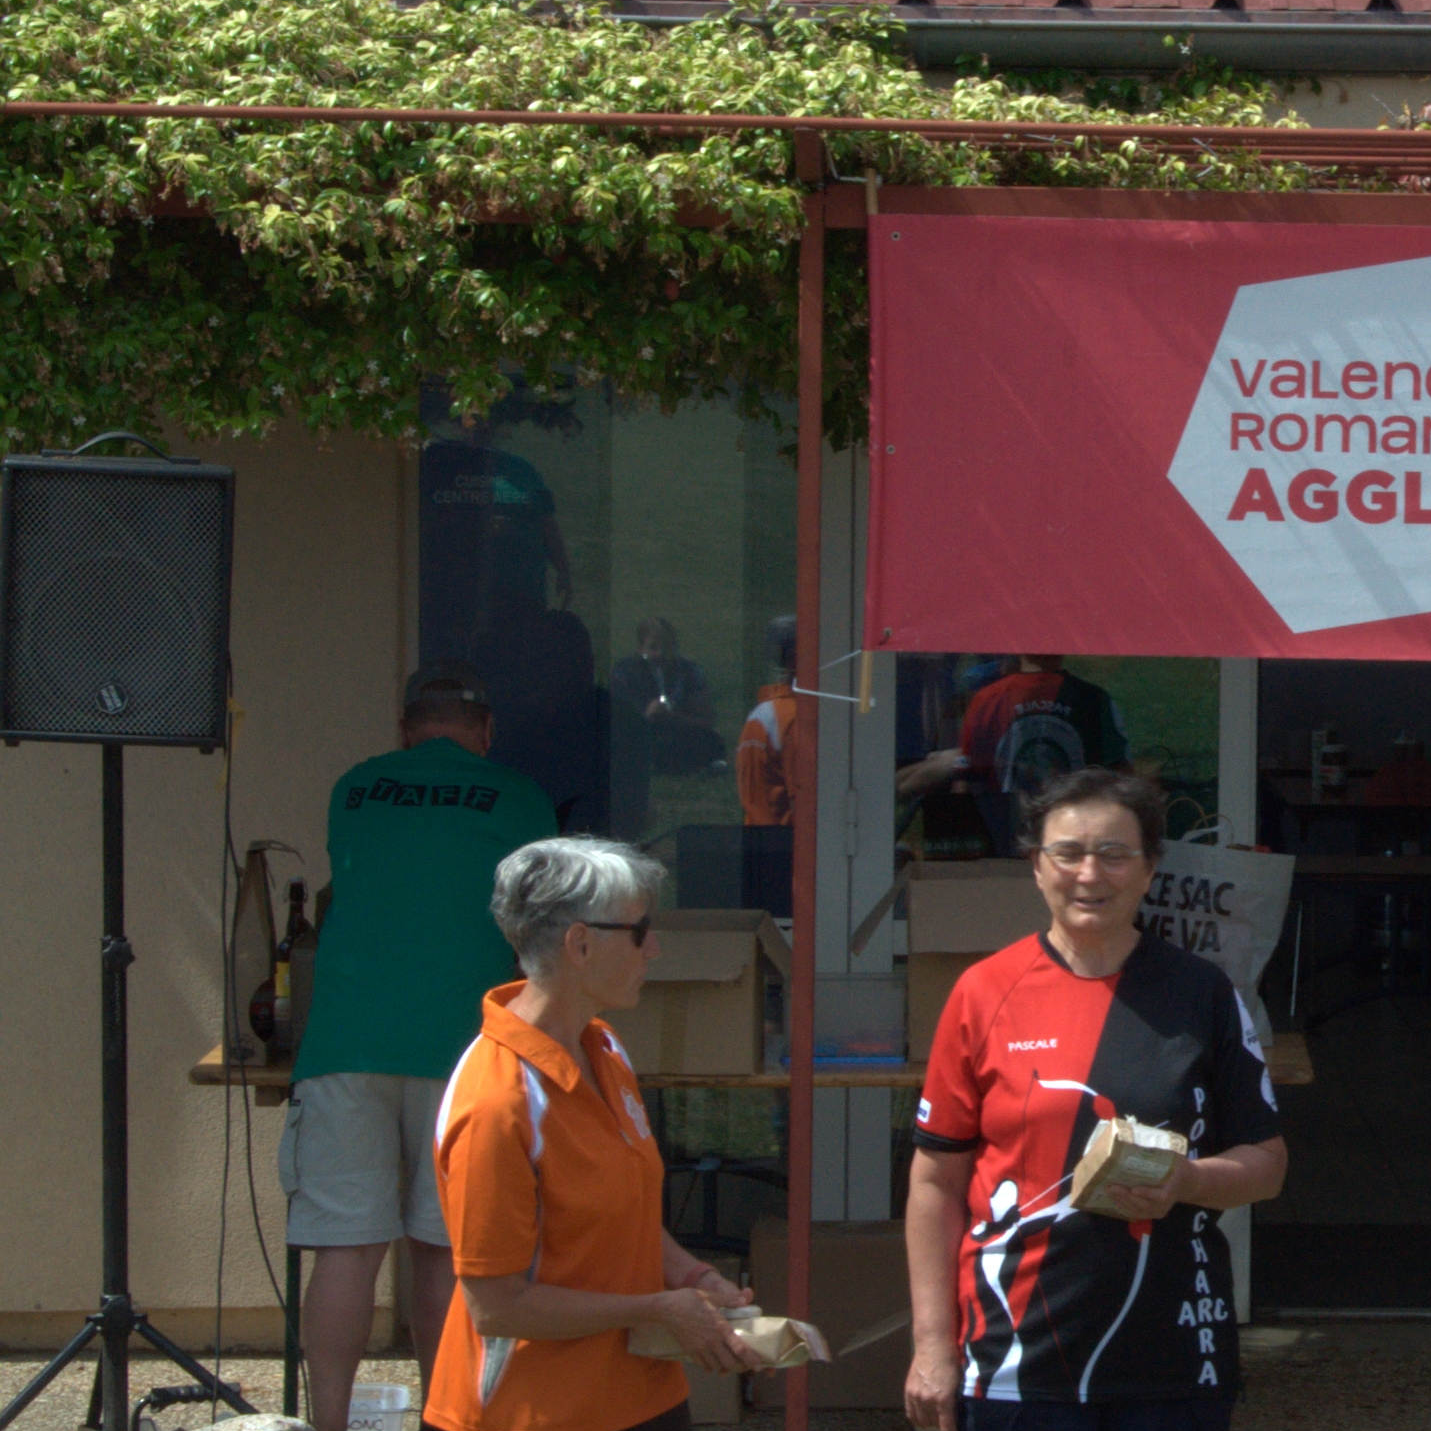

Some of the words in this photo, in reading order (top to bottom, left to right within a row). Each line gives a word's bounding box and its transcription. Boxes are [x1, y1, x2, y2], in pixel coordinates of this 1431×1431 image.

[346, 778, 498, 810] STAFF
[1176, 875, 1236, 917] SAC
[1181, 918, 1221, 953] VA
[1007, 1038, 1058, 1053] PASCALE
[1177, 1298, 1229, 1327] ARC
